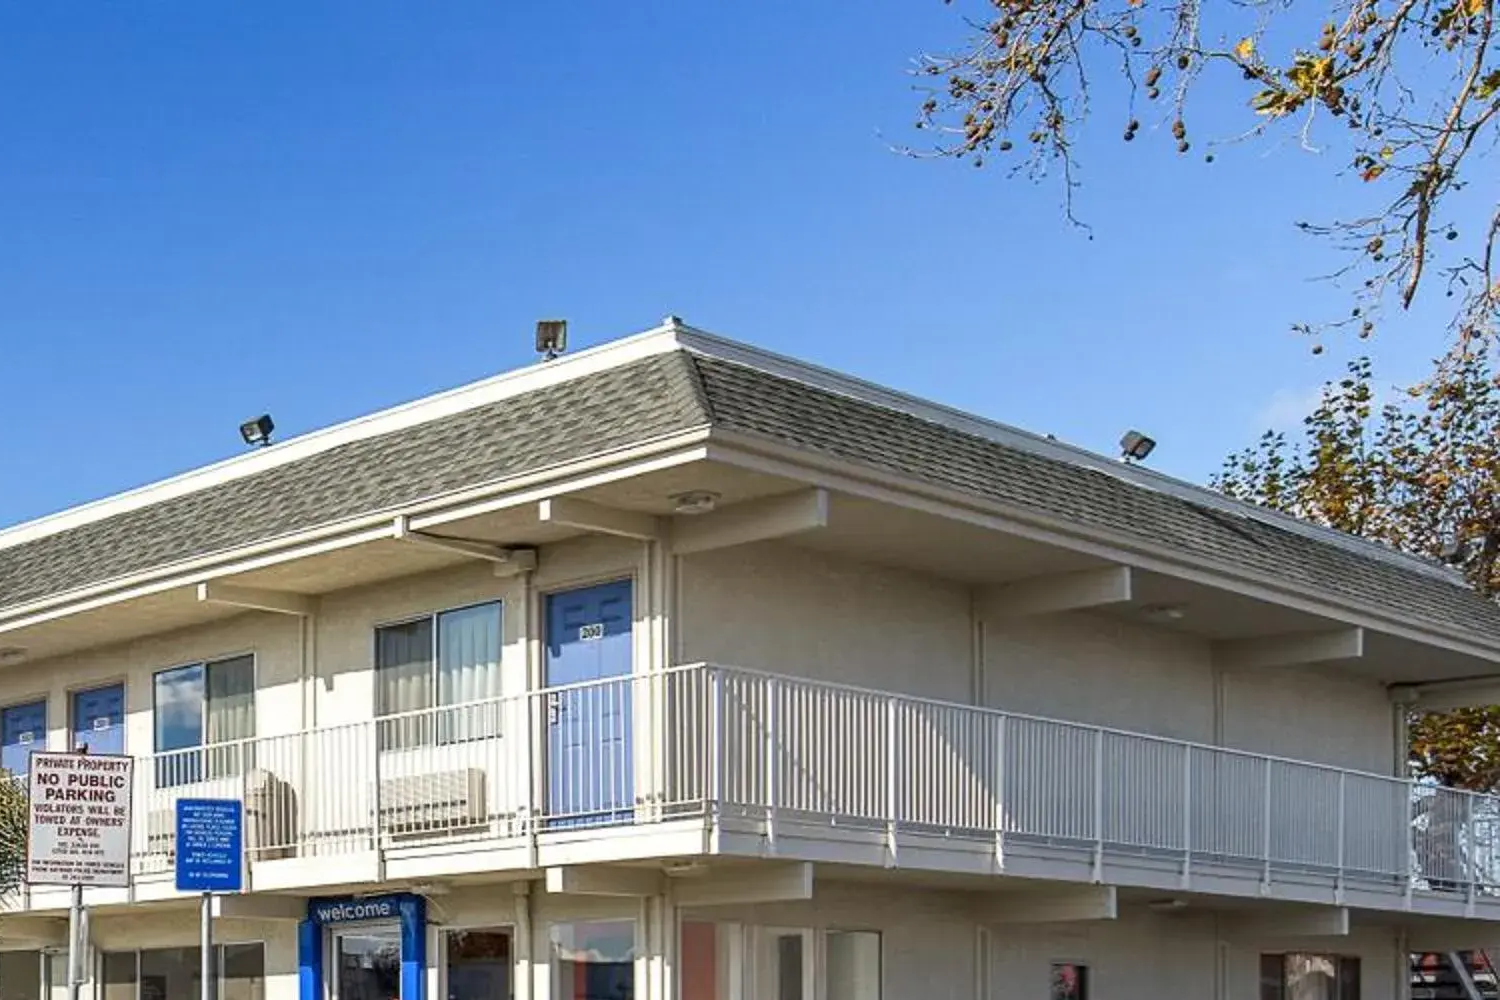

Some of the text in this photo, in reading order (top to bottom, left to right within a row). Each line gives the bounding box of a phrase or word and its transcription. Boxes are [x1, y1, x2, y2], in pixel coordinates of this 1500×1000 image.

[36, 758, 129, 773] PRIVATE PROPERTY
[37, 773, 125, 788] NO PUBLIC
[45, 788, 115, 802] PARKING
[34, 803, 126, 816] VIOLATORS WILL BE
[34, 814, 66, 824] TOWED
[70, 815, 82, 824] AT
[317, 902, 391, 920] welcome
